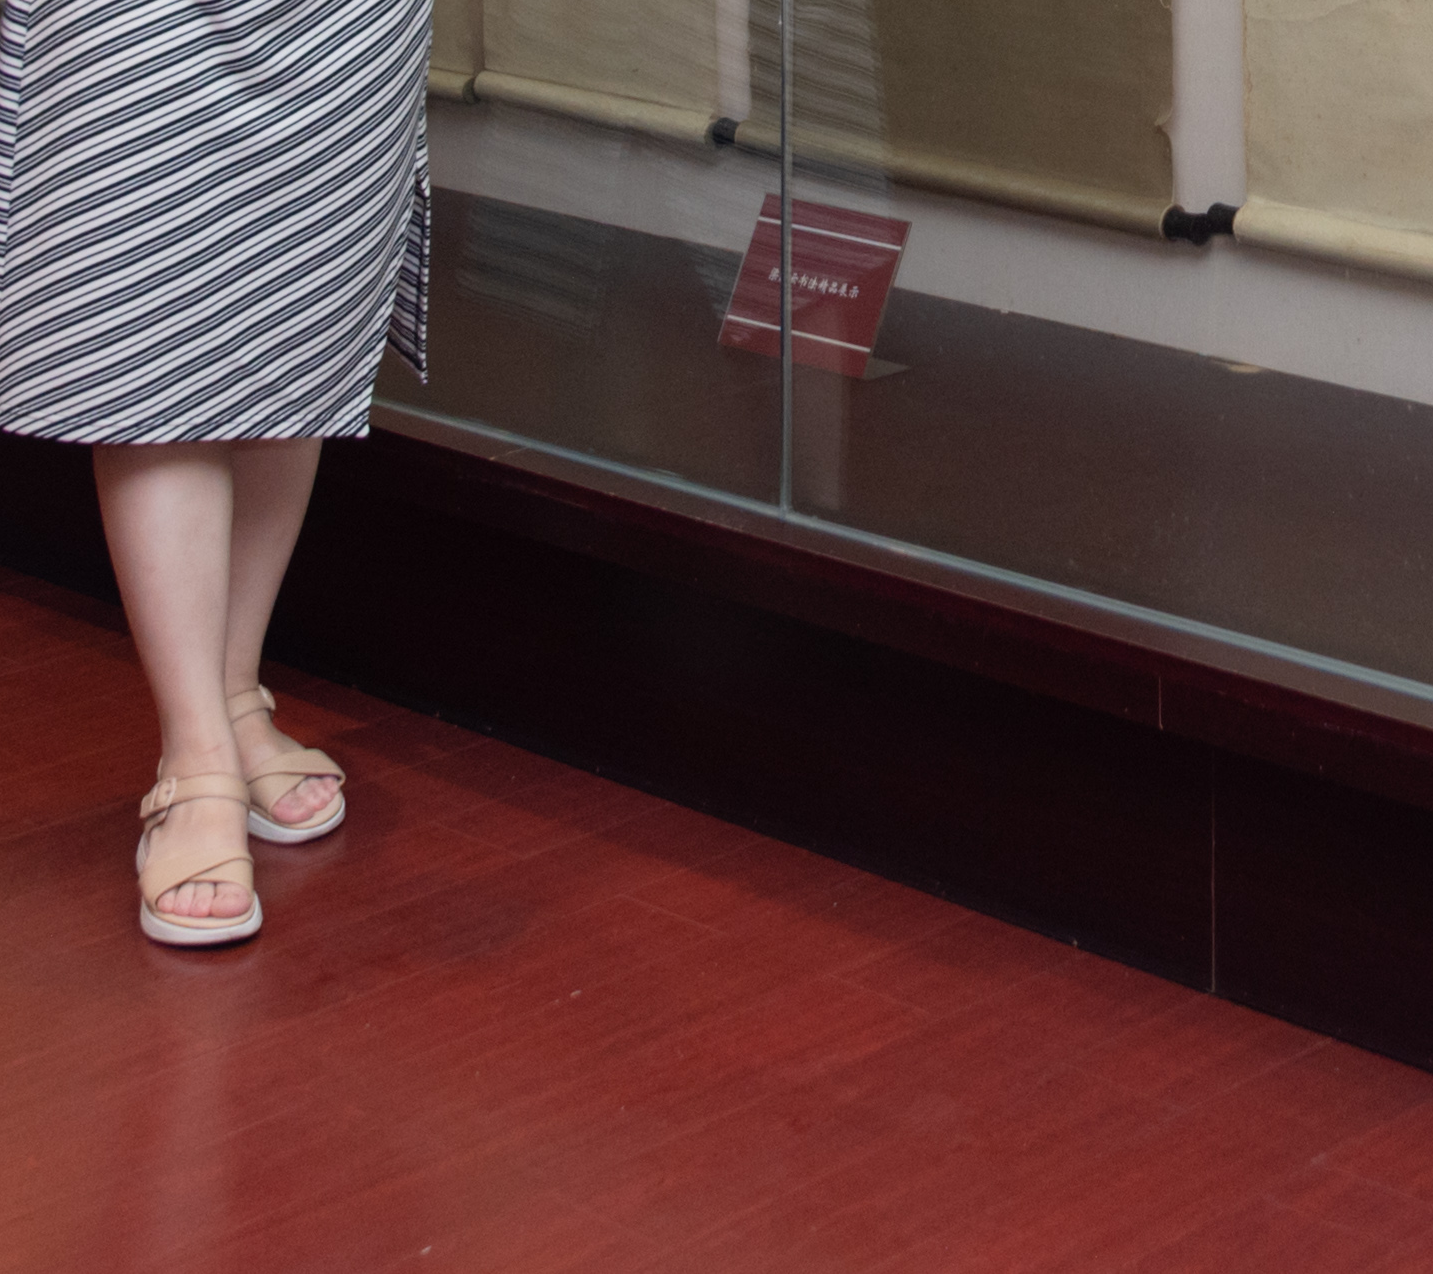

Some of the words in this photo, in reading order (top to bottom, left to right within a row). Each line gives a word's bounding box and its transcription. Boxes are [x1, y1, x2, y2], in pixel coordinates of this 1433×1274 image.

[767, 267, 860, 299] 梁云书法精品展示
